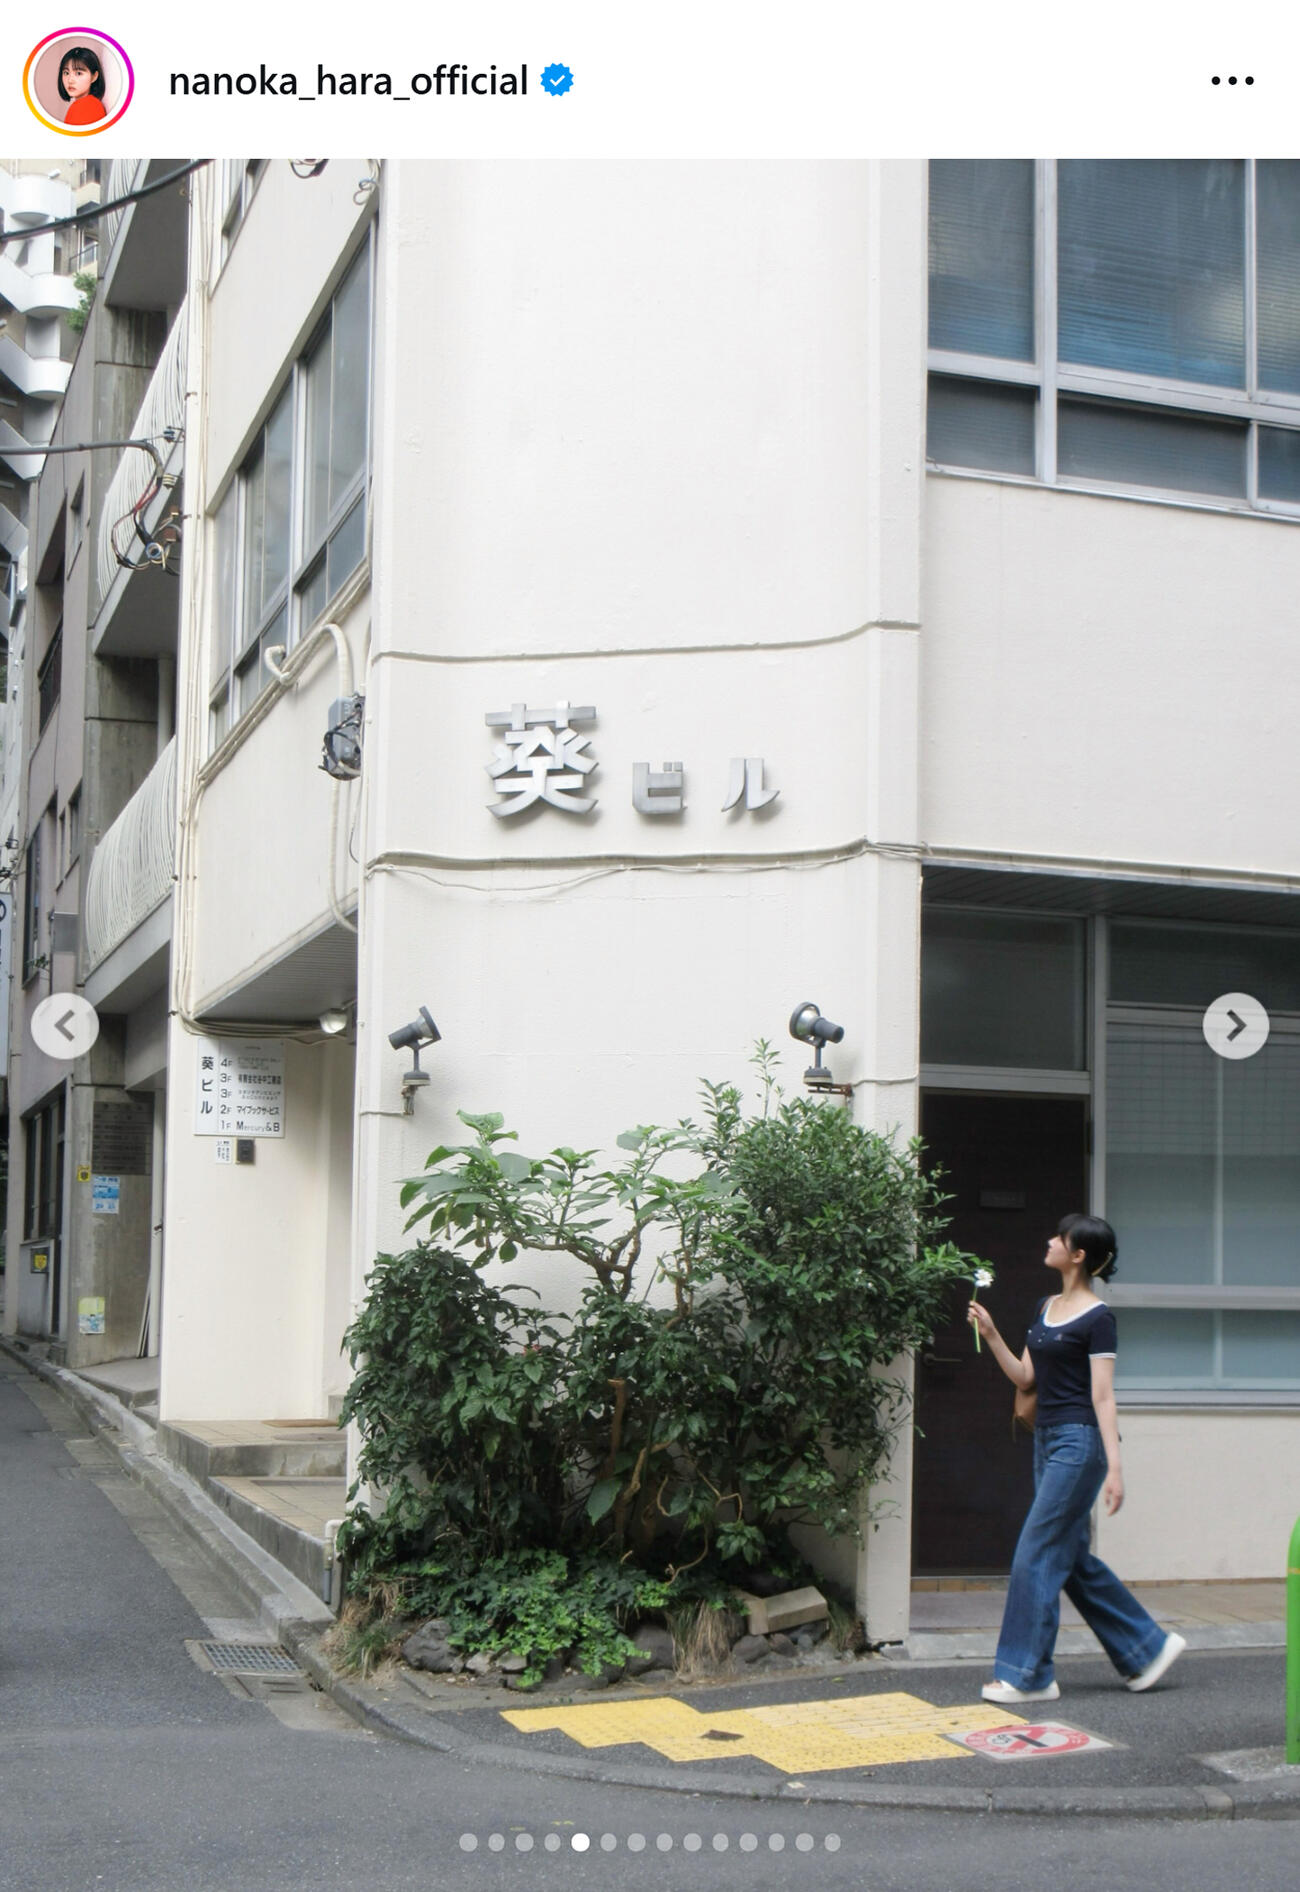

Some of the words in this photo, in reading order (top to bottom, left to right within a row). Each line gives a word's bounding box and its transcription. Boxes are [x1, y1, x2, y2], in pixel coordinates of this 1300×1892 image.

[484, 700, 782, 820] 葵ビル
[220, 1058, 232, 1067] 4F
[200, 1056, 214, 1115] 葵ビル
[220, 1089, 232, 1098] 3F
[220, 1105, 232, 1115] 2F
[221, 1120, 231, 1130] 1F
